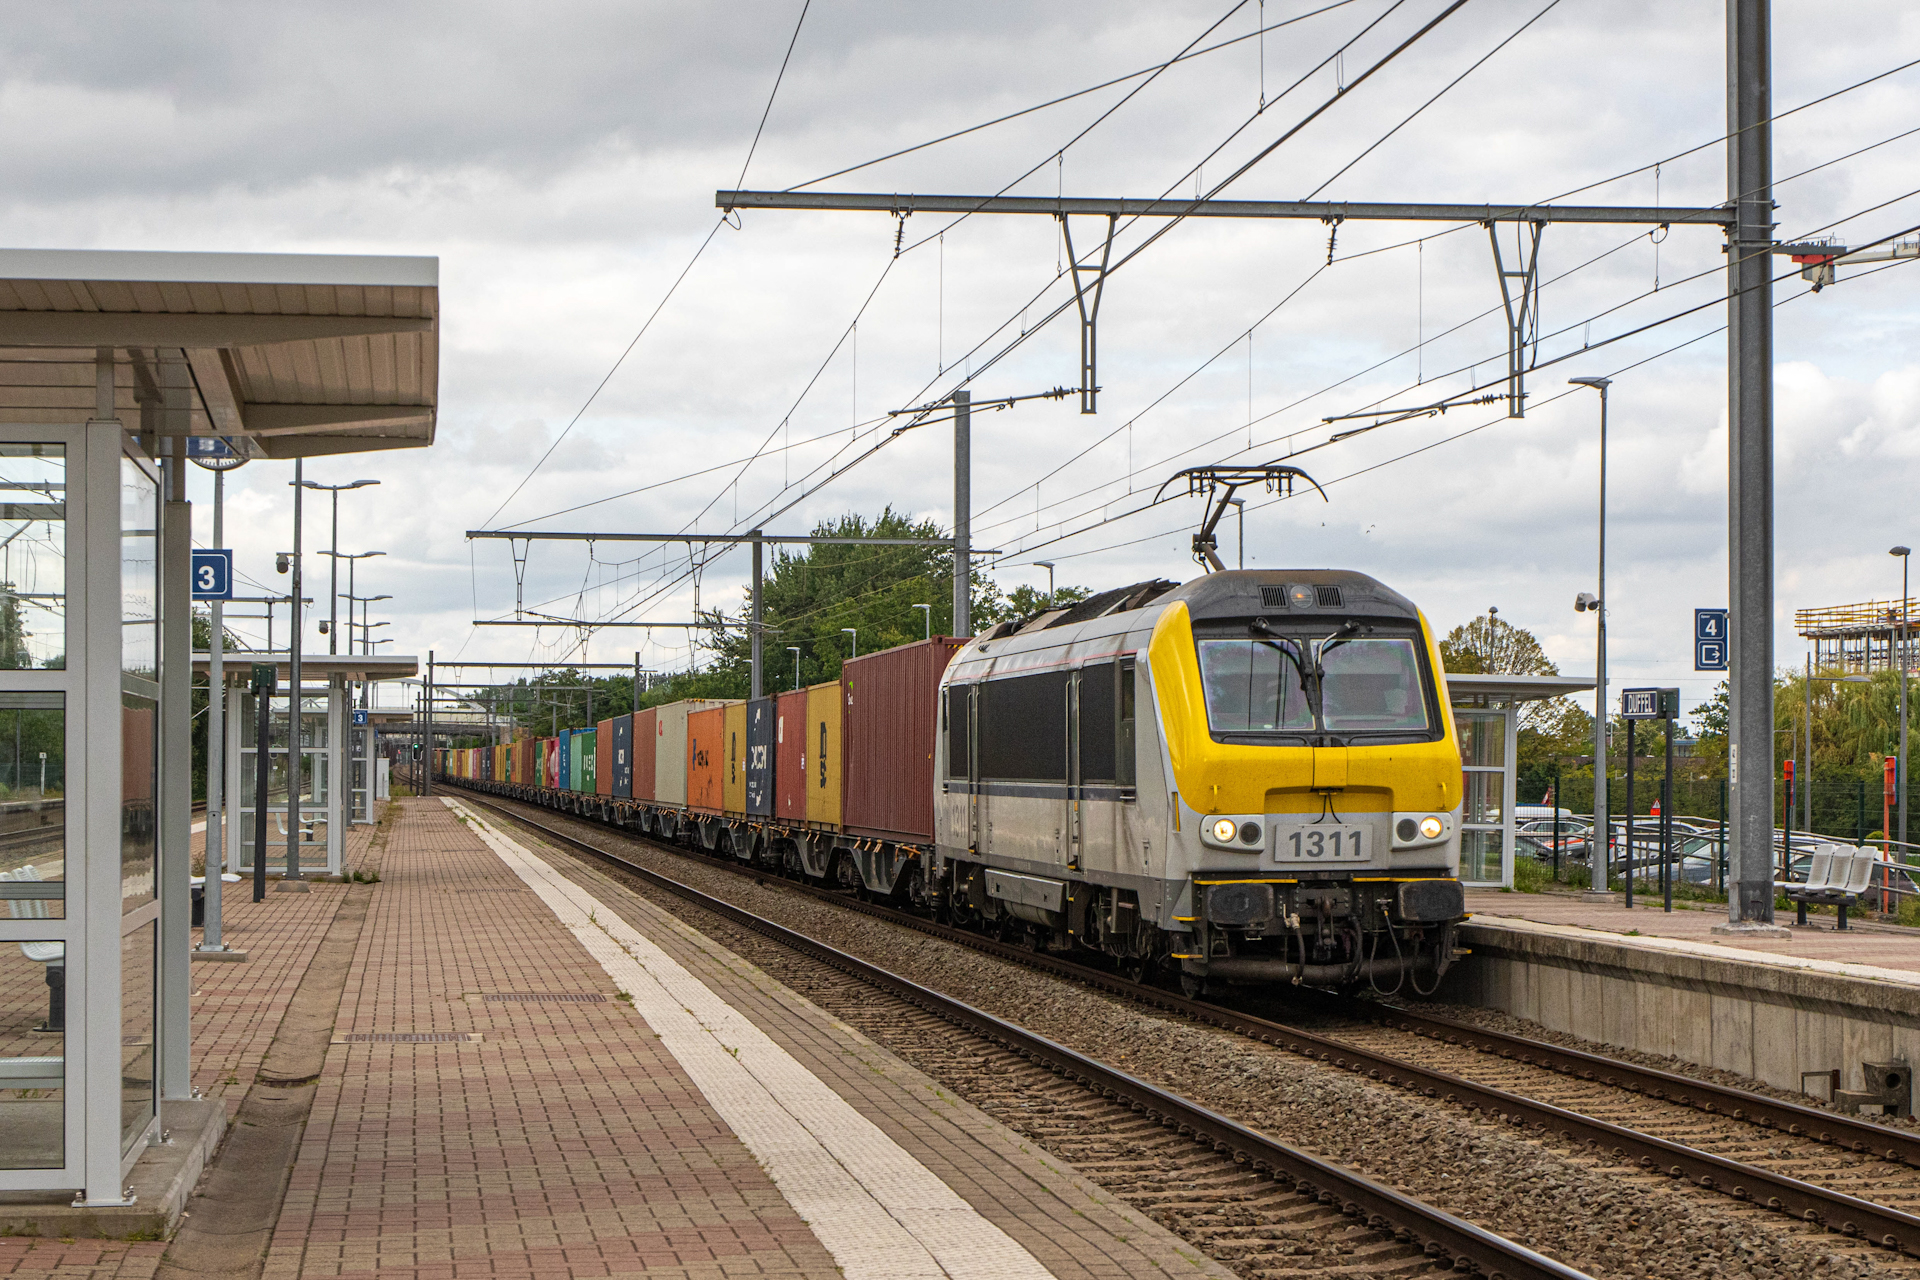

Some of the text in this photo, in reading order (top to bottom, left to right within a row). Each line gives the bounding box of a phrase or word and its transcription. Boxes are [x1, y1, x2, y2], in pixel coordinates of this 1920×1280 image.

[198, 565, 215, 590] 3
[1705, 619, 1717, 635] 4
[1628, 693, 1653, 713] DUFFEL
[357, 714, 363, 722] 3
[952, 804, 966, 838] 1311
[1289, 830, 1362, 858] 1311
